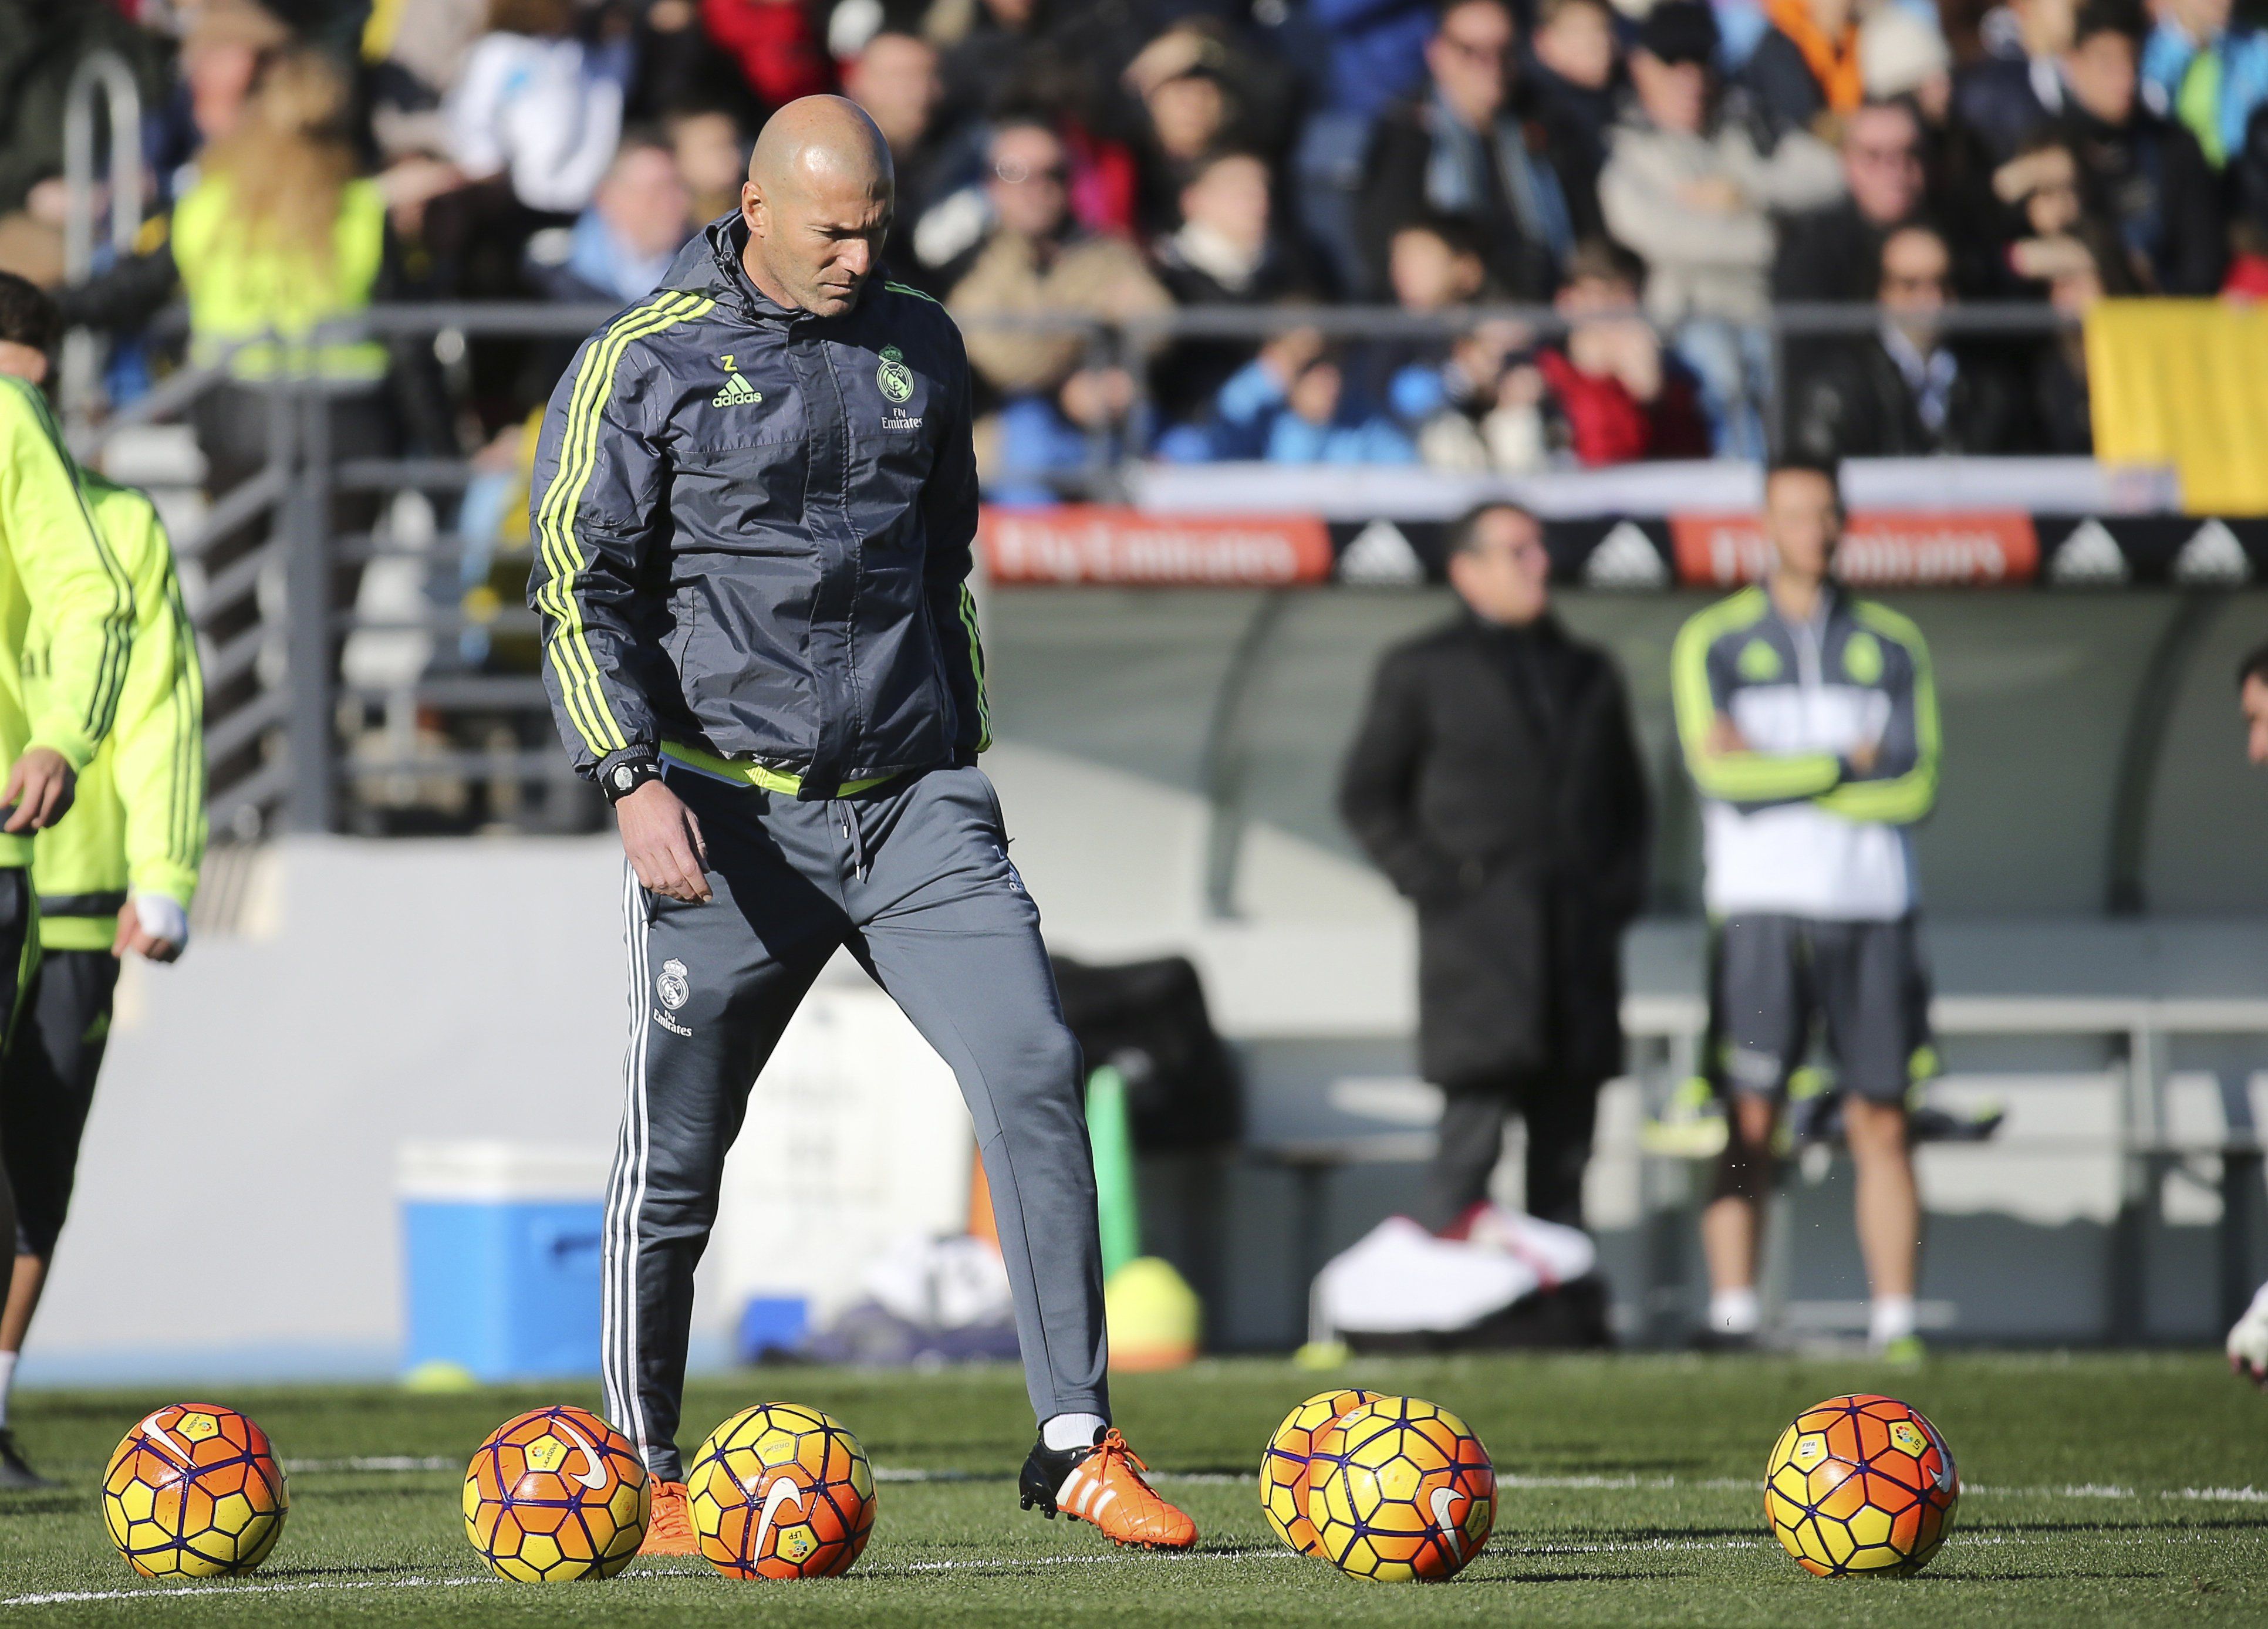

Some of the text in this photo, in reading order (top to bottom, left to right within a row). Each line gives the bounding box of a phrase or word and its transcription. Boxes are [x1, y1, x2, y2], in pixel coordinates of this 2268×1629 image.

[720, 354, 738, 371] Z
[712, 391, 762, 408] adidas
[893, 407, 906, 418] Fly
[881, 416, 923, 430] Emirates
[653, 1008, 692, 1037] Emirates
[664, 1009, 676, 1023] Fly
[1912, 1438, 1922, 1450] LFP
[788, 1530, 802, 1540] LFP
